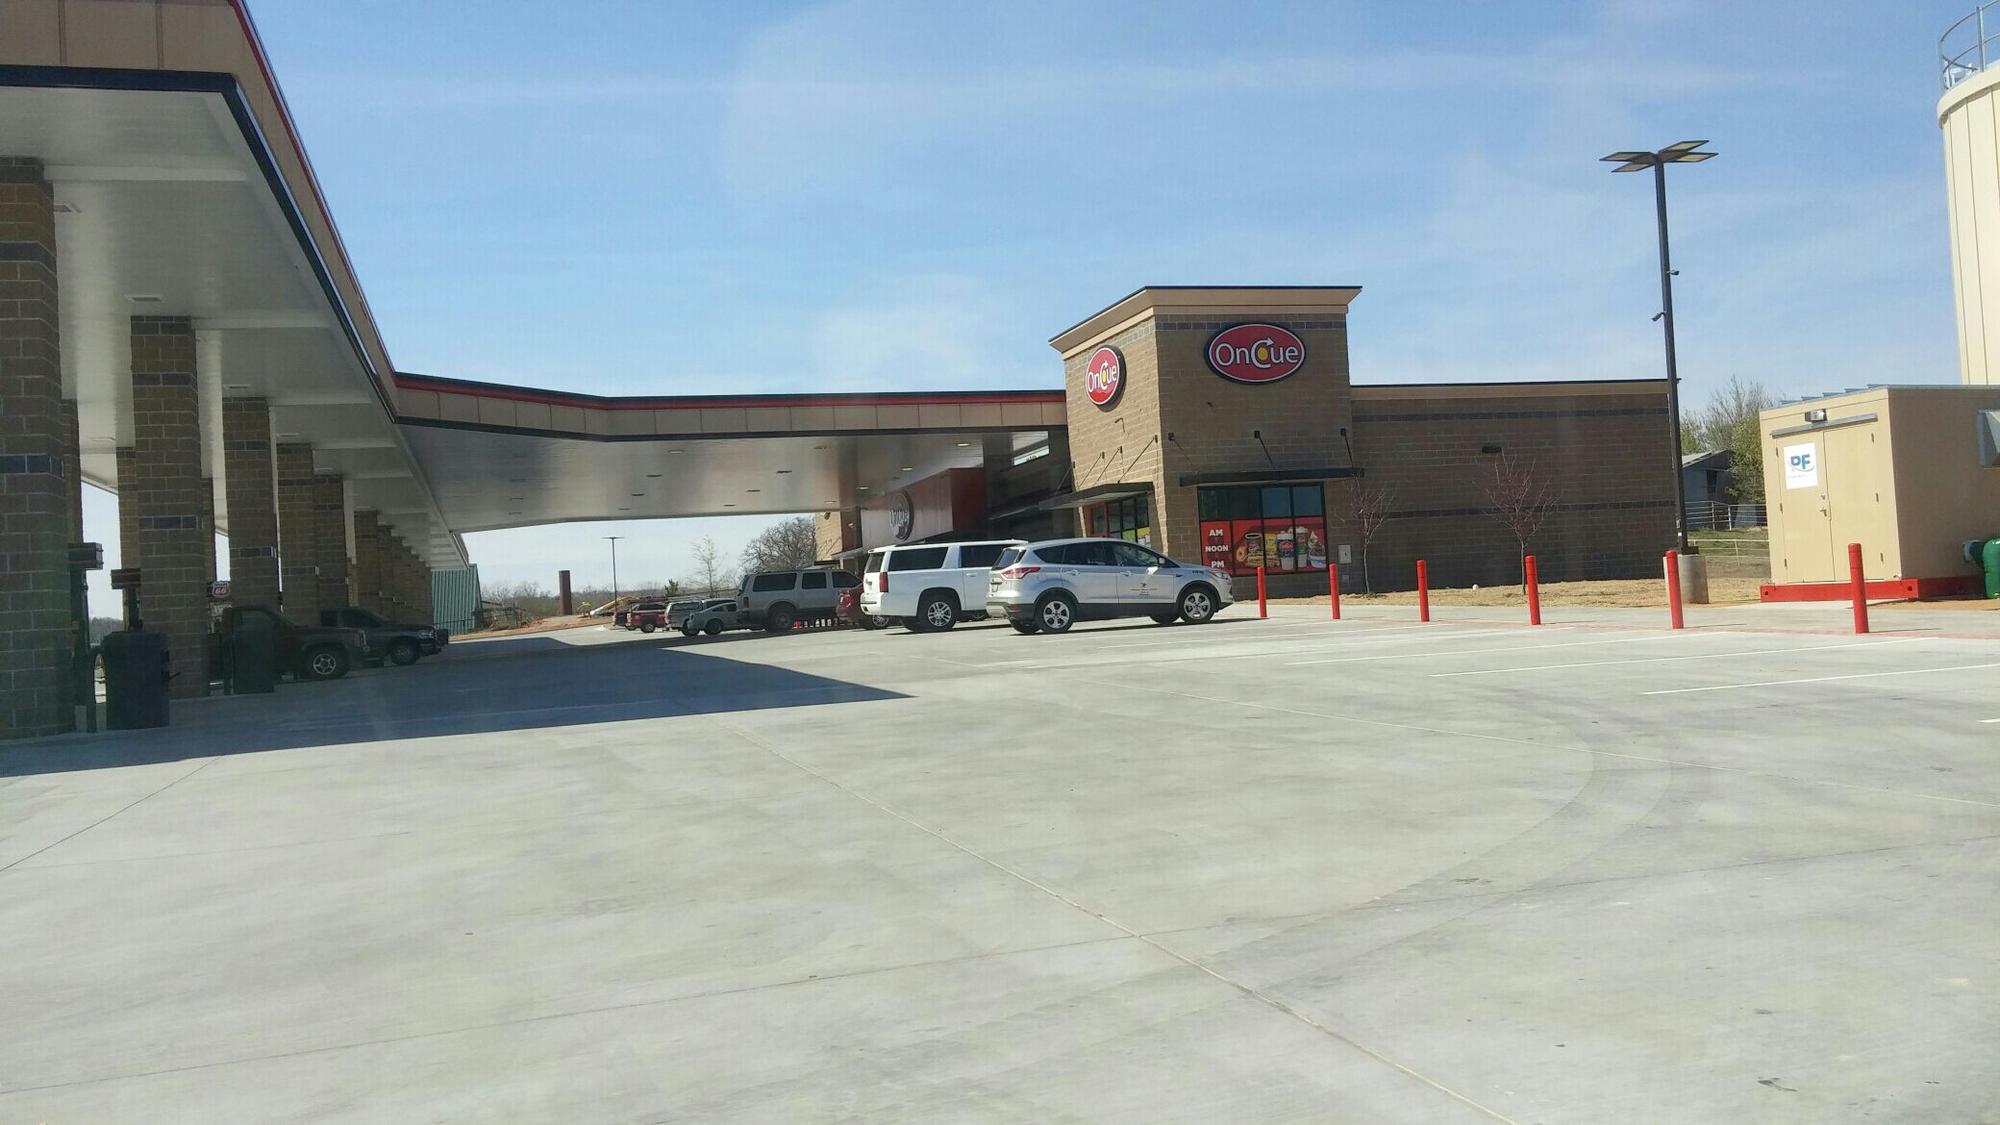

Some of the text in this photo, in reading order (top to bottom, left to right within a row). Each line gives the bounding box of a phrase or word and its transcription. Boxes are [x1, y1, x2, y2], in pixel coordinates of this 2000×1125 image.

[1215, 337, 1299, 369] OnCue
[1087, 360, 1117, 393] OnCue
[1209, 529, 1223, 537] AM
[1211, 560, 1225, 568] PM
